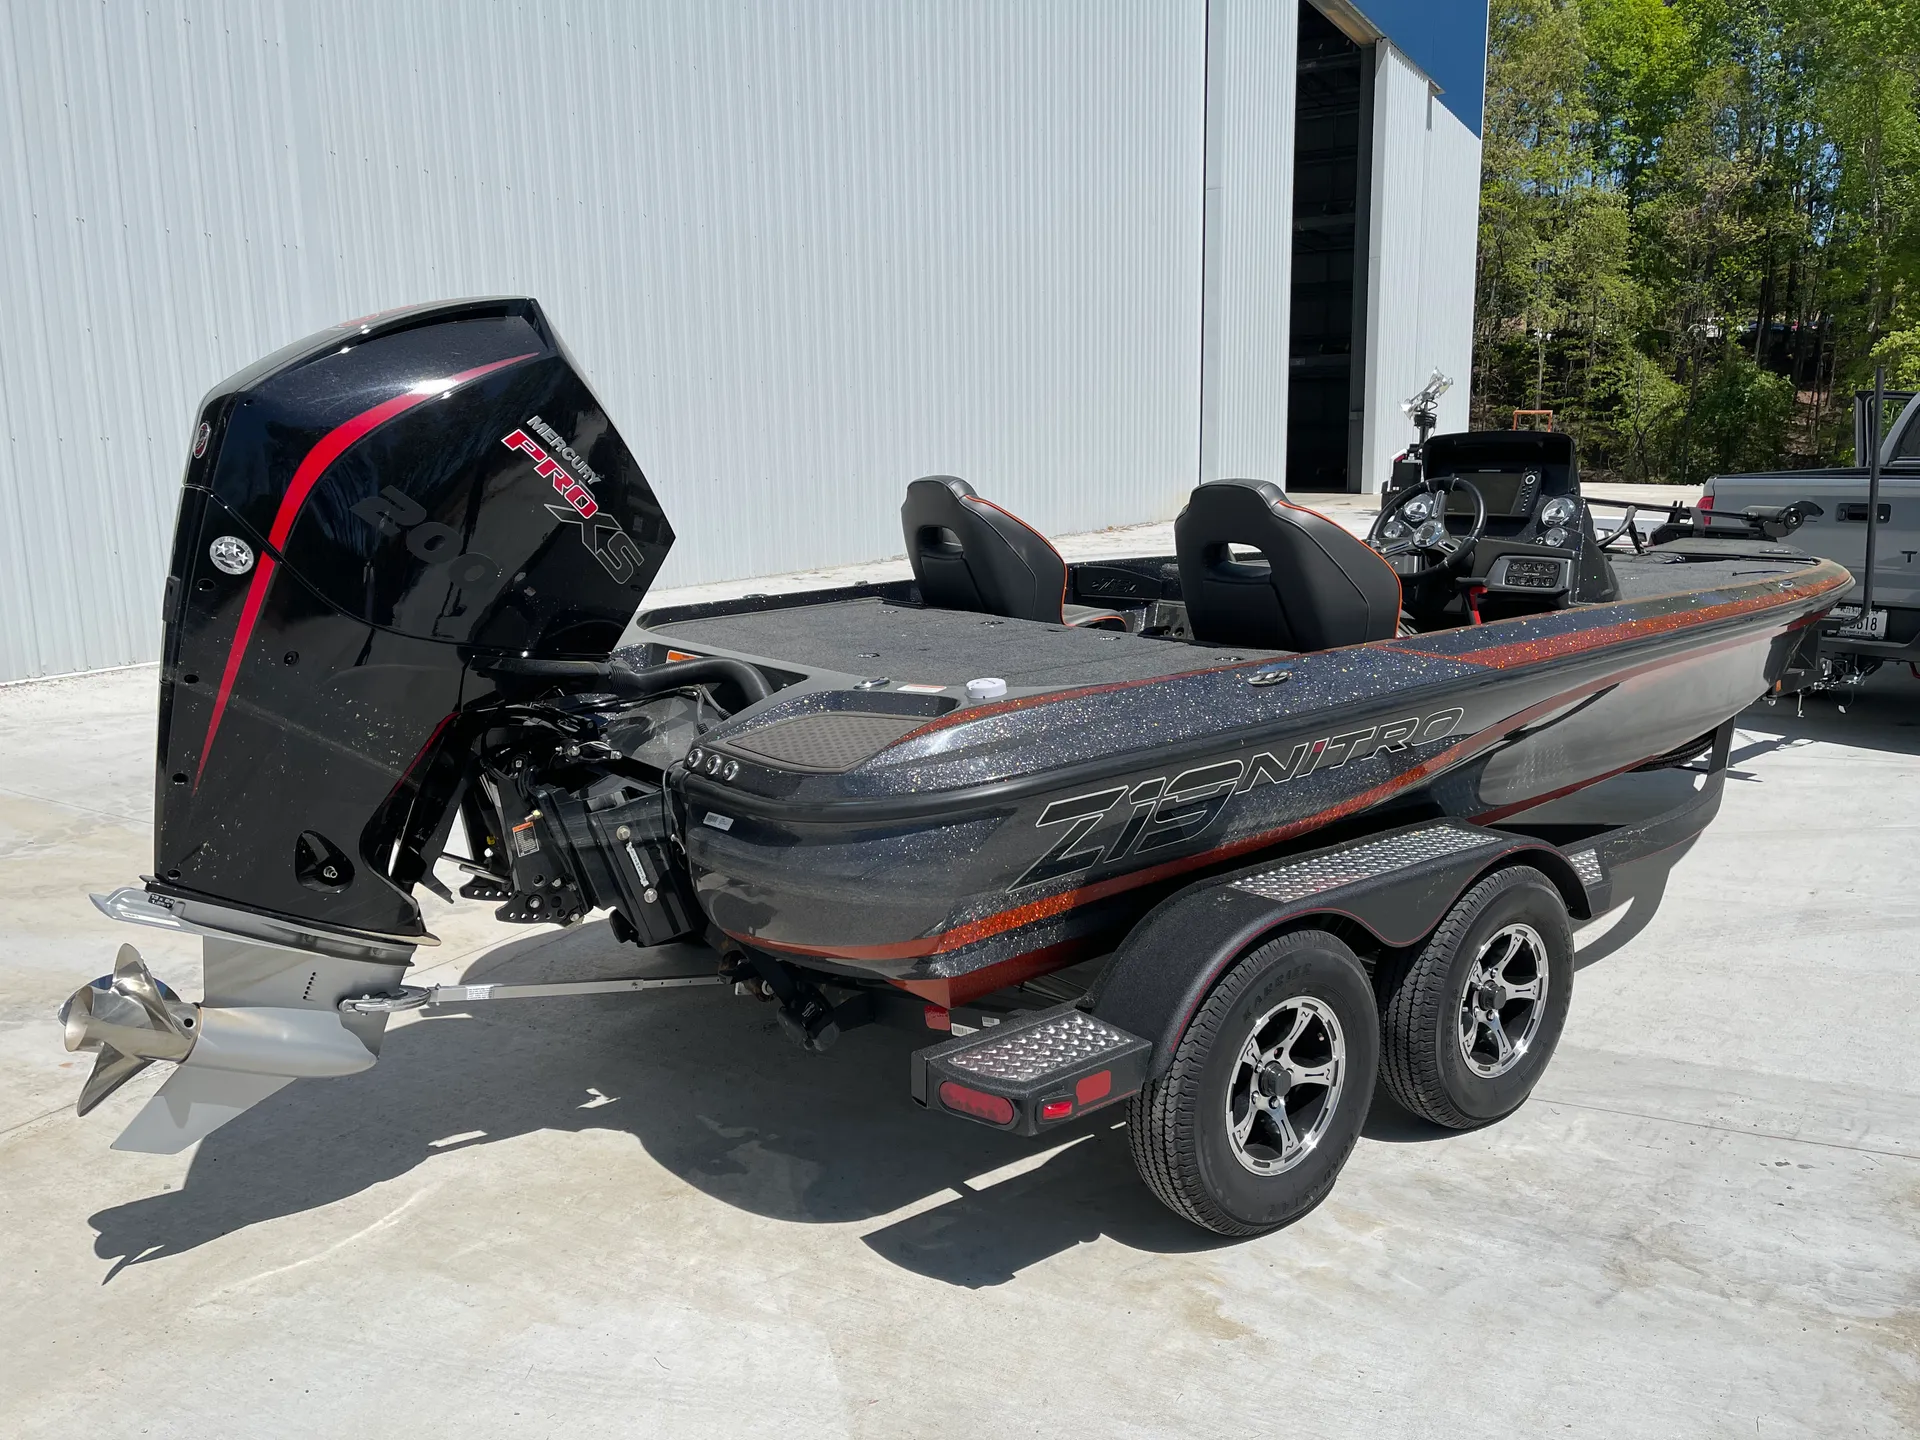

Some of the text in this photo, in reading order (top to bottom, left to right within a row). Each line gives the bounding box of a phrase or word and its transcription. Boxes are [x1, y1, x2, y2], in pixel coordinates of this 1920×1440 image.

[501, 428, 599, 519] PRO
[526, 415, 602, 485] MERCURY
[350, 484, 500, 590] 200
[544, 479, 645, 584] XS
[1006, 707, 1465, 893] Z19 NITRO
